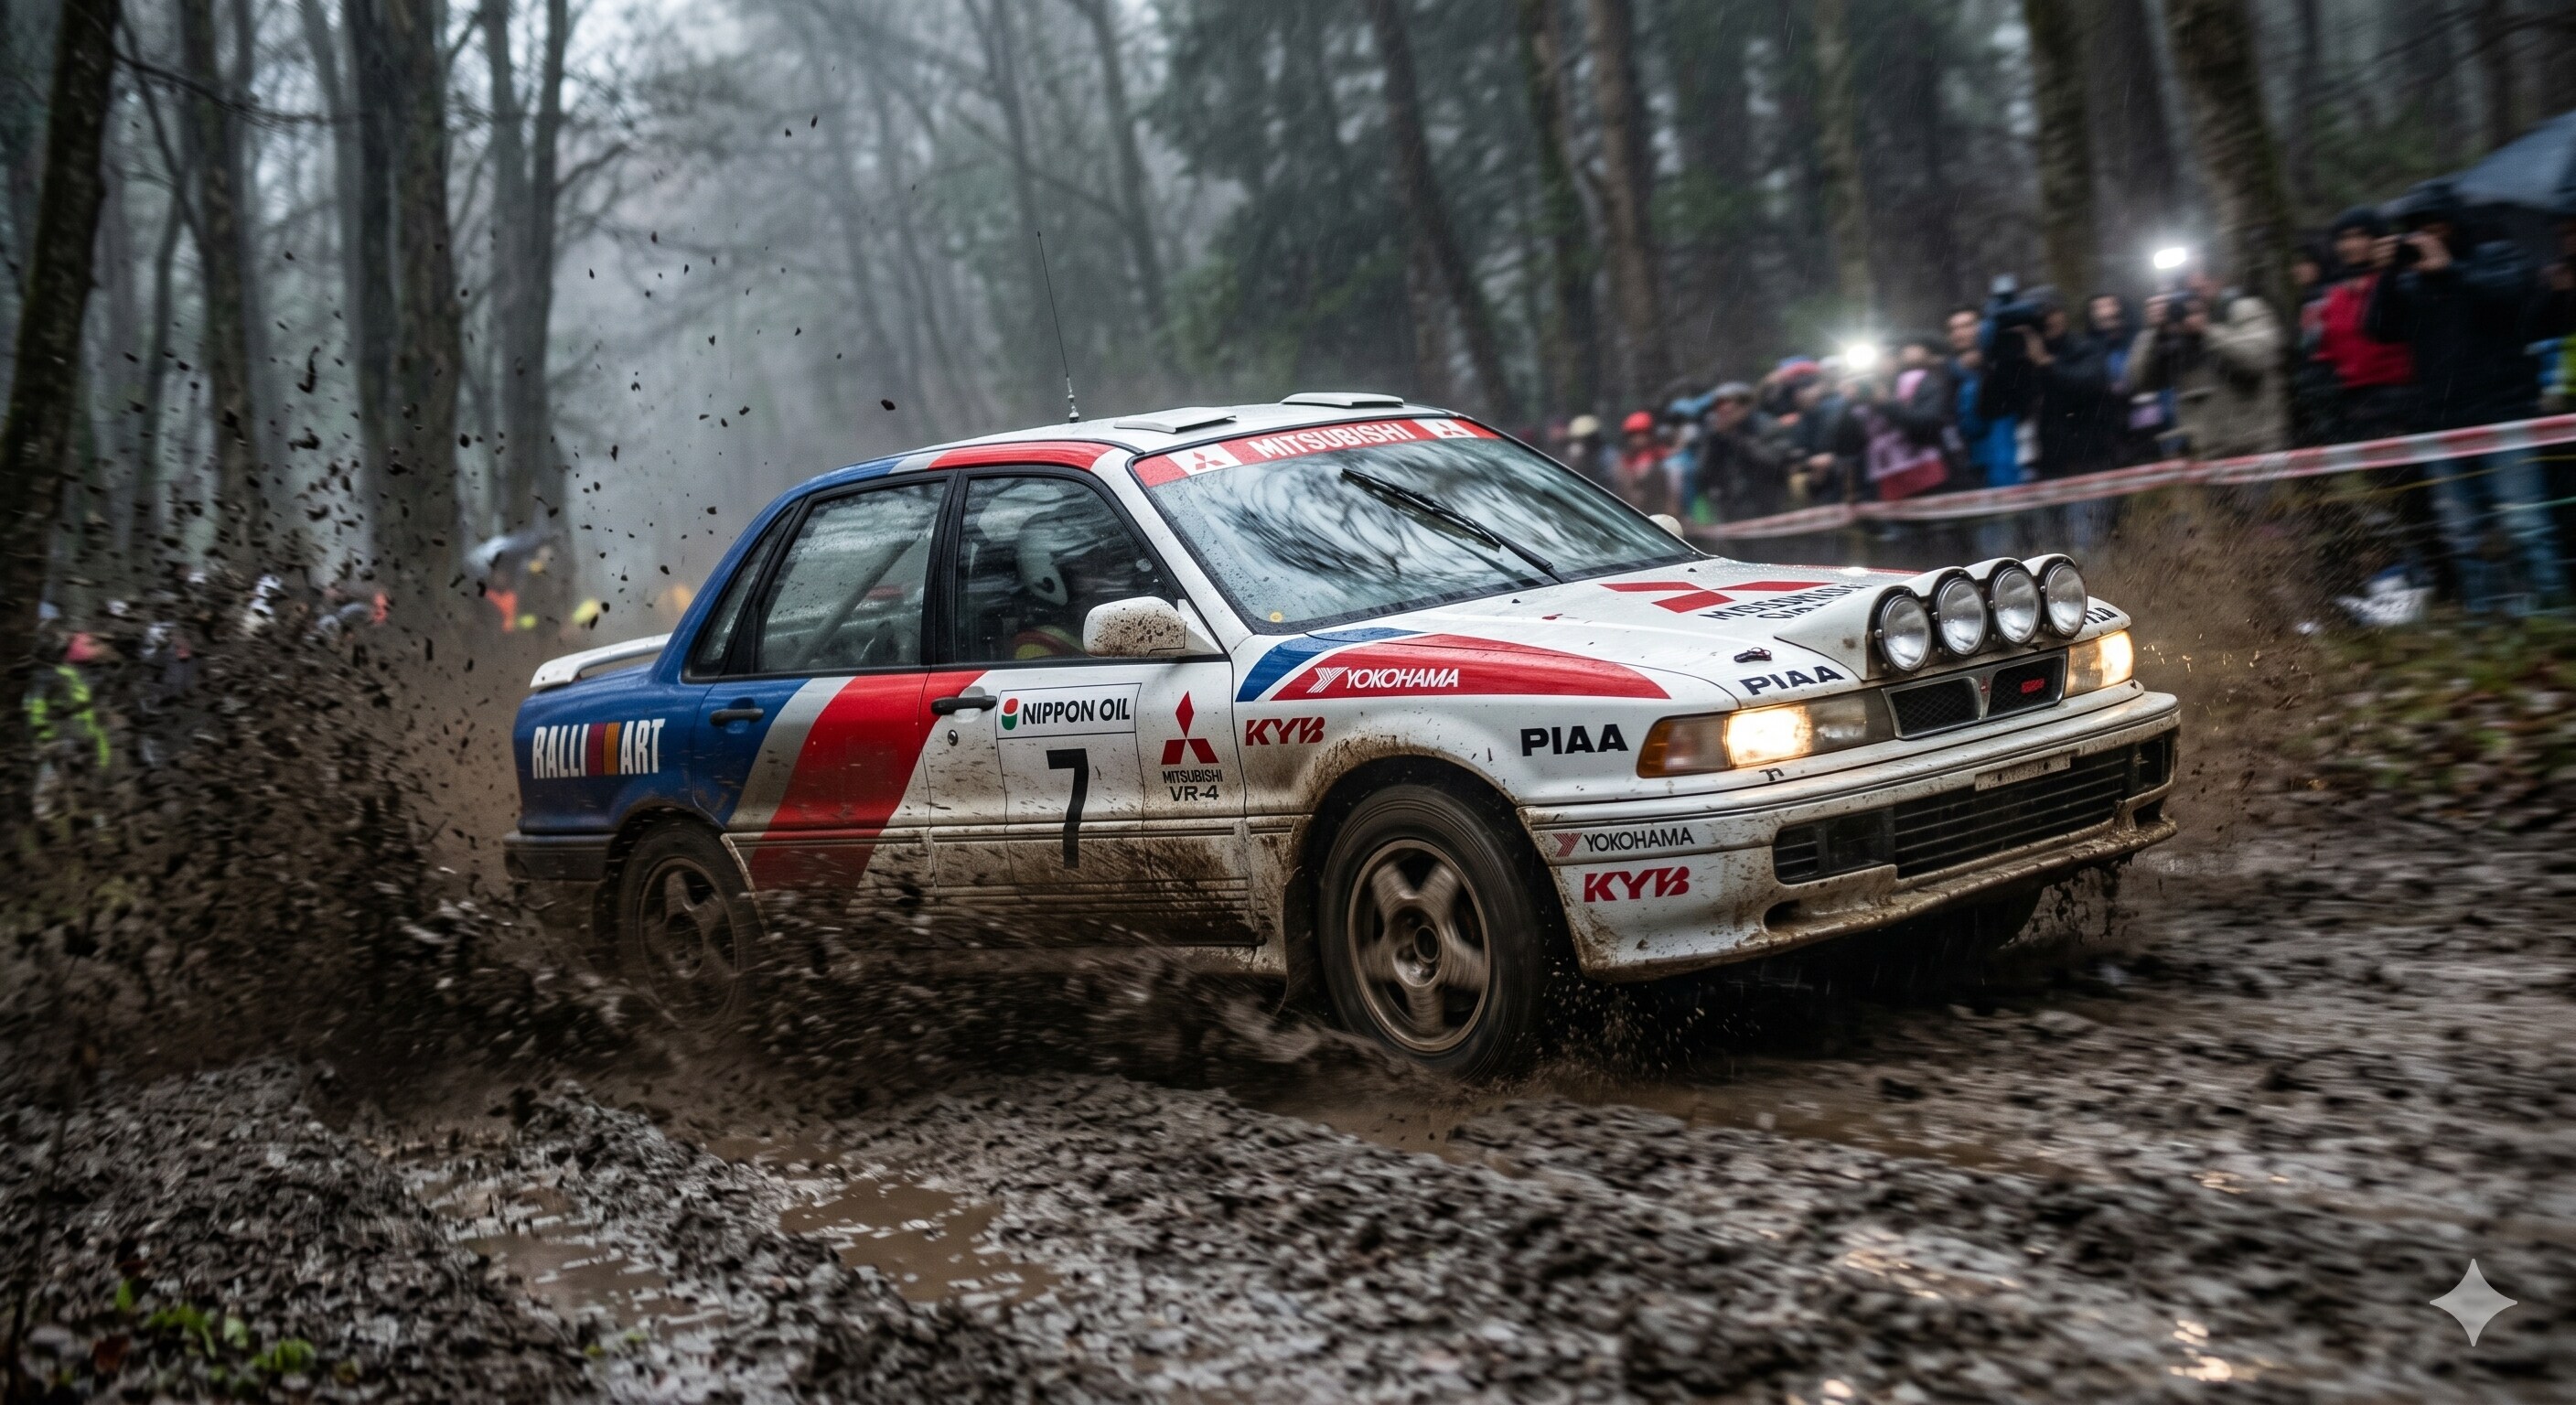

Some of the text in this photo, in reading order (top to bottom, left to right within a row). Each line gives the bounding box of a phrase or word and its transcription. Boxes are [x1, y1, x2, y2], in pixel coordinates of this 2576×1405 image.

[1247, 423, 1417, 458] MITSUBISHI
[1346, 668, 1459, 689] YOKOHAMA
[1739, 666, 1845, 695] PIAA
[1022, 698, 1130, 725] NIPPON OIL
[1245, 716, 1326, 746] KYB
[1520, 724, 1629, 757] PIAA
[532, 718, 666, 779] RALLI ART
[1162, 768, 1224, 784] MITSUBISHI
[1046, 748, 1089, 868] 7
[1169, 785, 1219, 802] VR-4
[1583, 827, 1695, 853] YOKOHAMA
[1583, 866, 1690, 903] KYB
